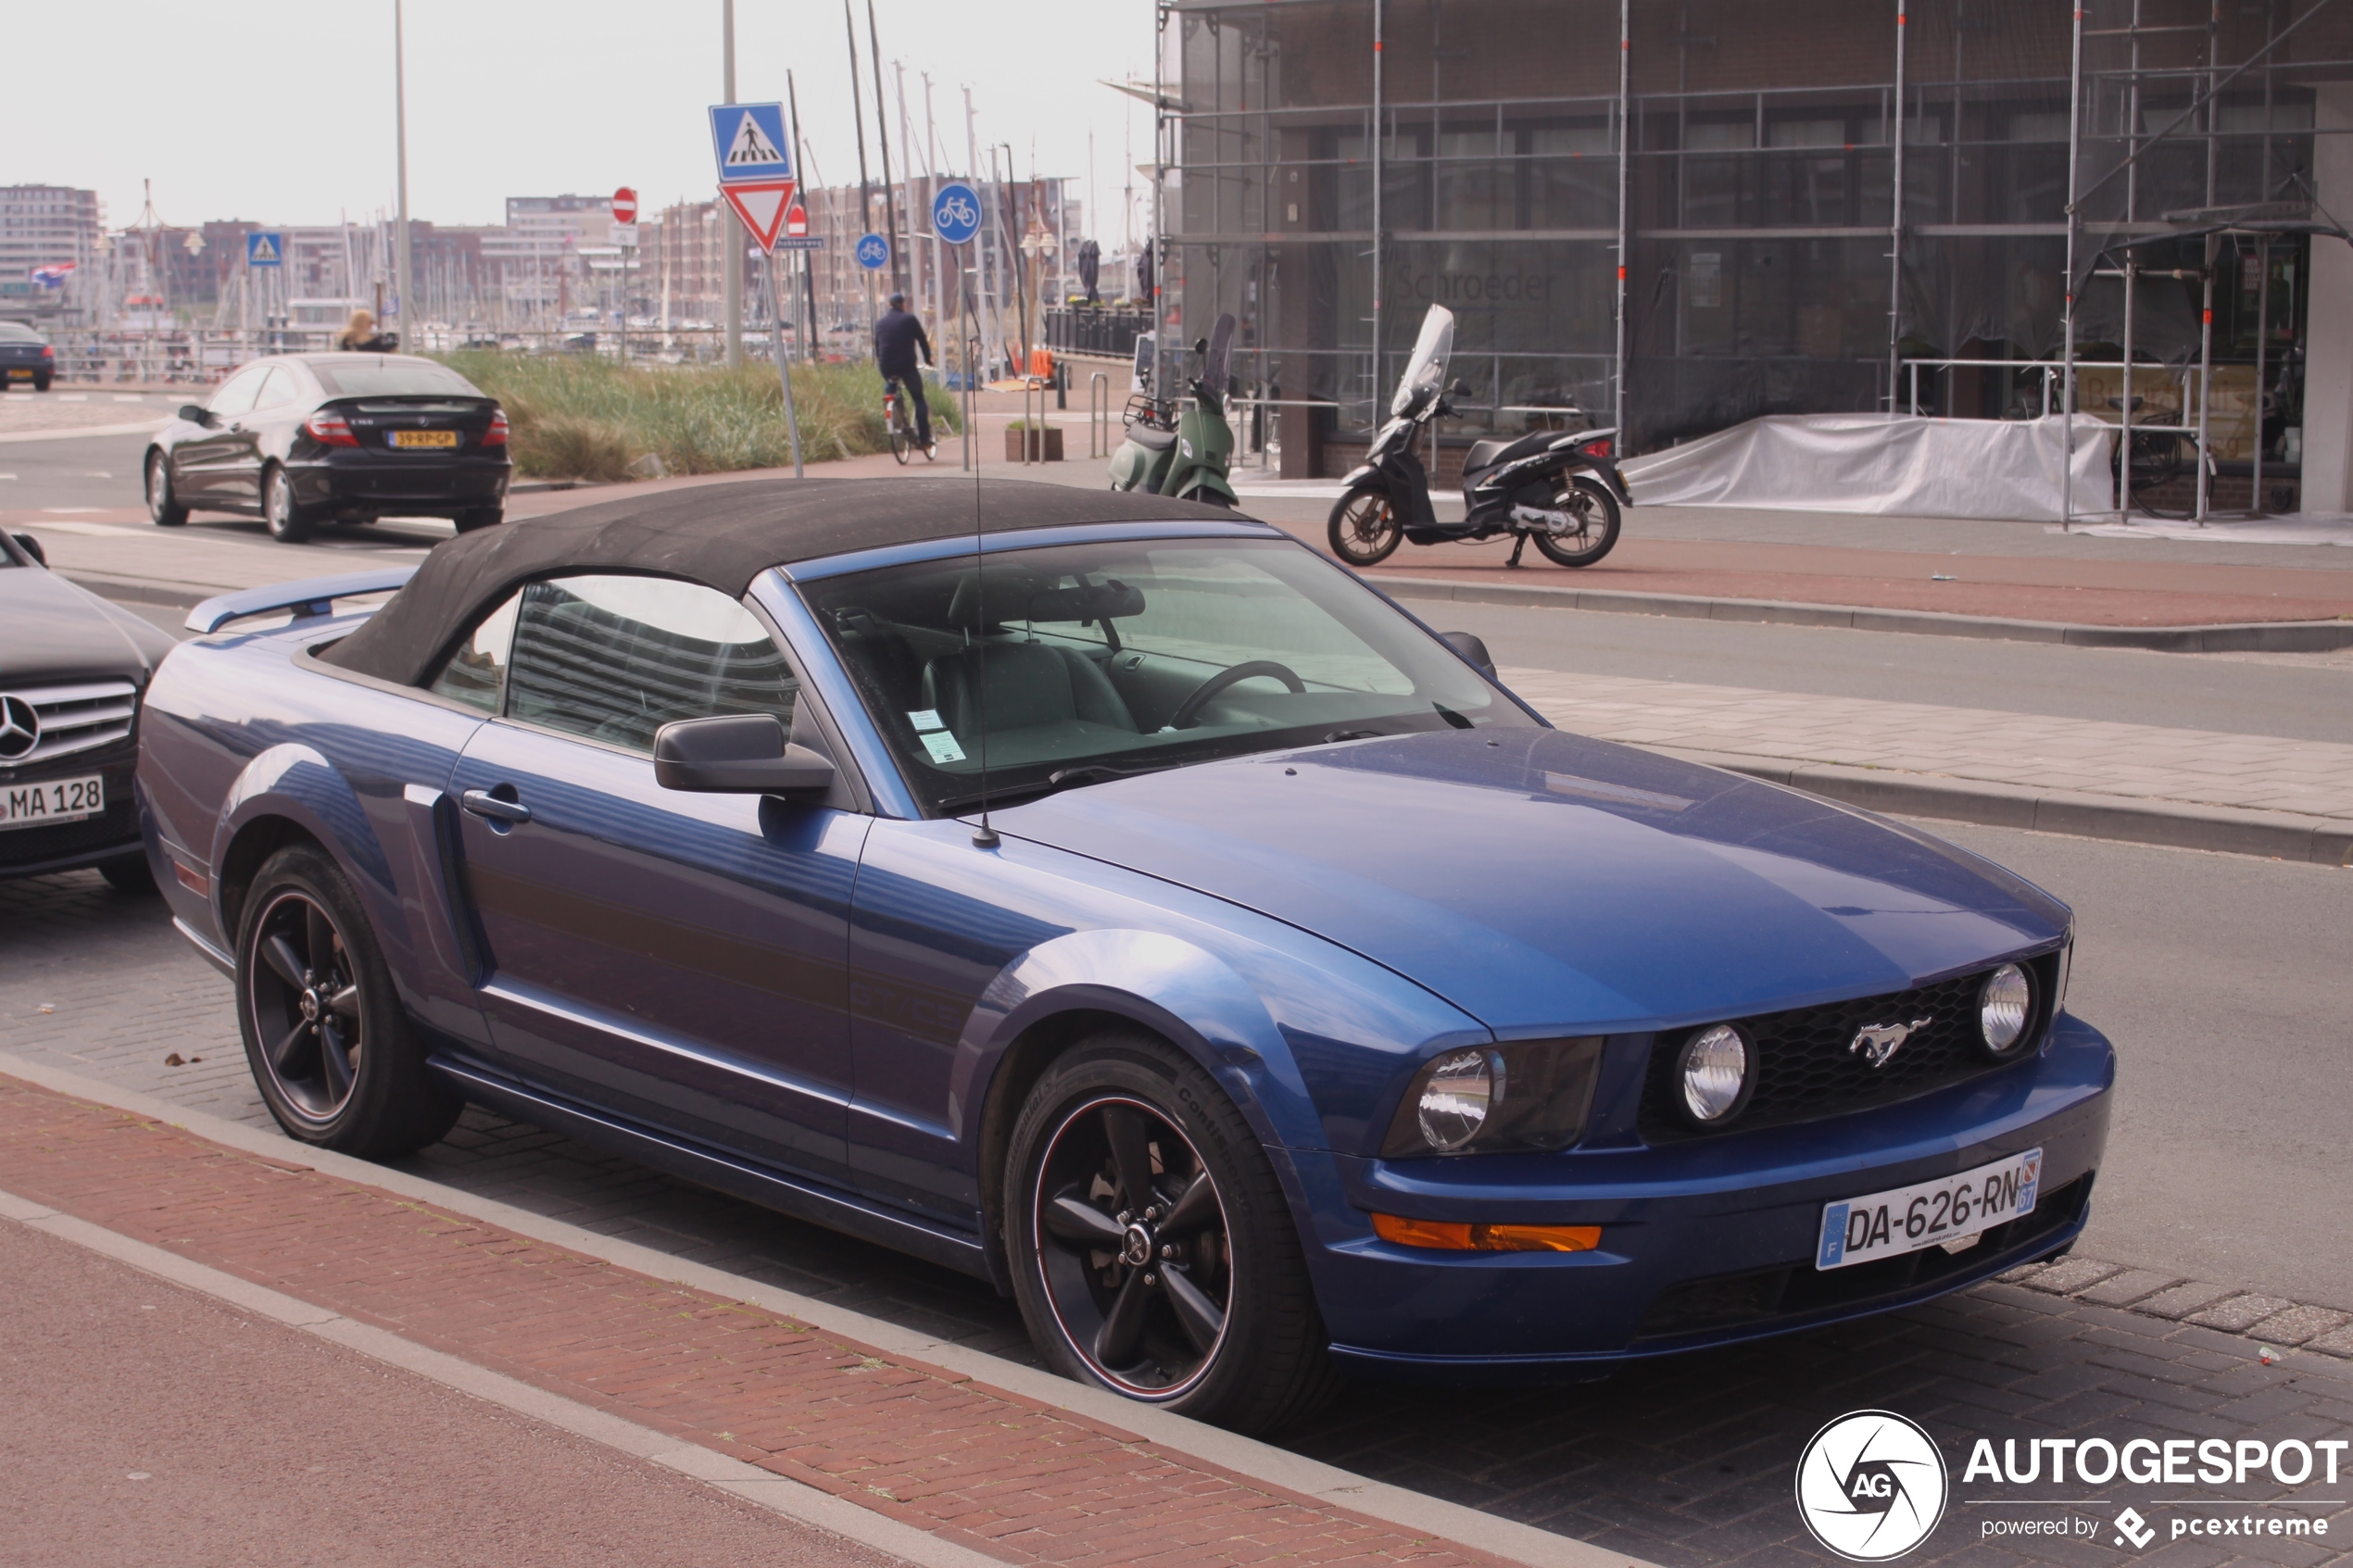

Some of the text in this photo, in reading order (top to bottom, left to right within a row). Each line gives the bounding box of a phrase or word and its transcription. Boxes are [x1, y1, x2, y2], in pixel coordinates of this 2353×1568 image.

[778, 238, 823, 248] hokkerweg
[1397, 264, 1556, 301] Schroeder
[398, 433, 452, 444] 39-RP-GP
[10, 781, 100, 818] MA 128
[850, 981, 962, 1031] GT/CS
[1845, 1167, 2020, 1253] DA-626-RN
[2019, 1186, 2035, 1210] 67
[1827, 1242, 1837, 1258] F
